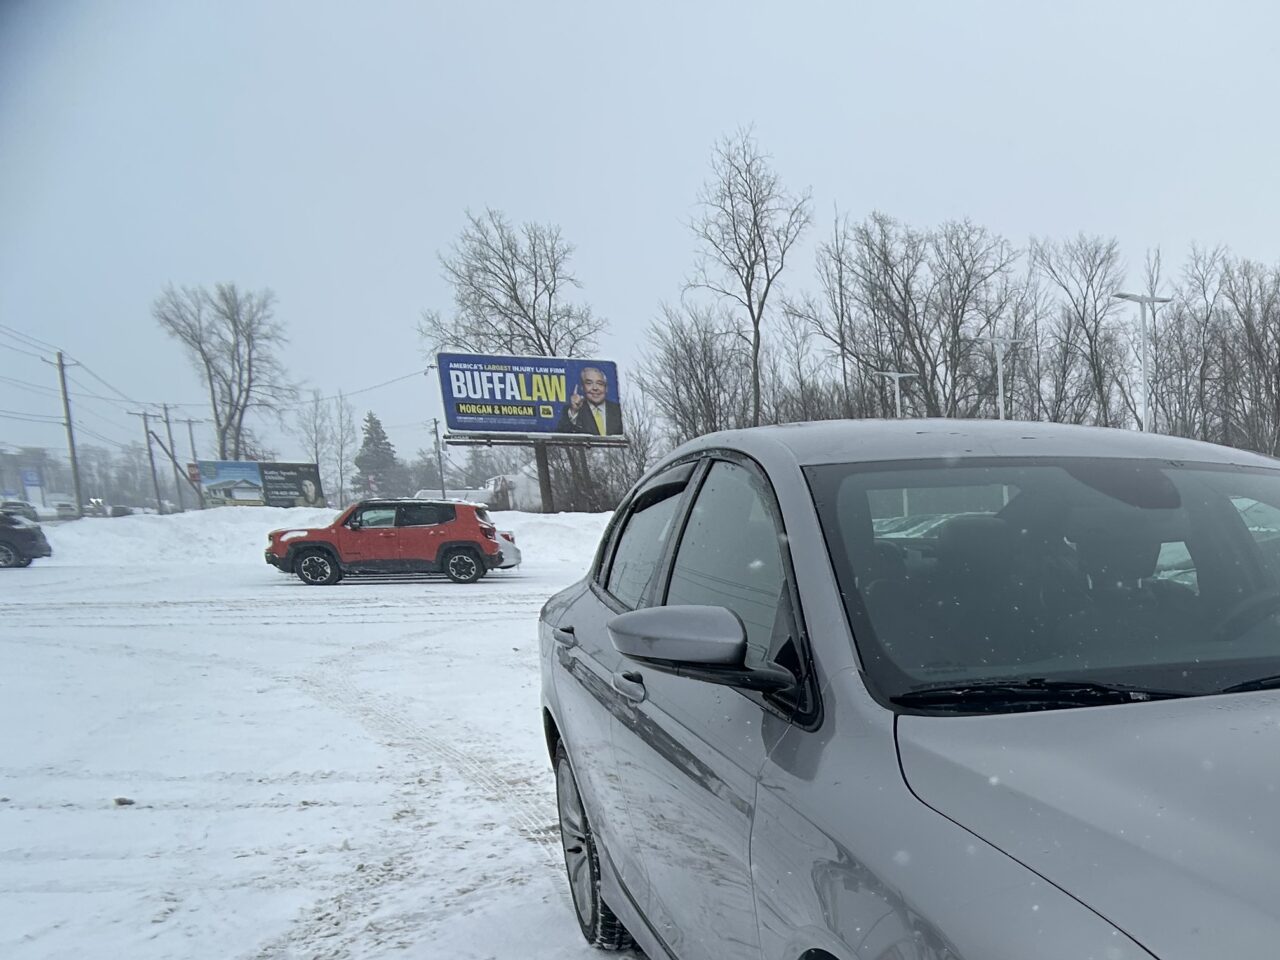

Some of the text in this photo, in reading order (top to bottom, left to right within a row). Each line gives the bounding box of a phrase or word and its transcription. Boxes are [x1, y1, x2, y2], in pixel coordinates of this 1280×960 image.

[449, 362, 483, 370] AMERICA'S
[449, 370, 567, 402] BUFFALAW
[459, 403, 492, 414] MORGAN
[494, 405, 501, 414] &
[501, 405, 534, 416] MORGAN
